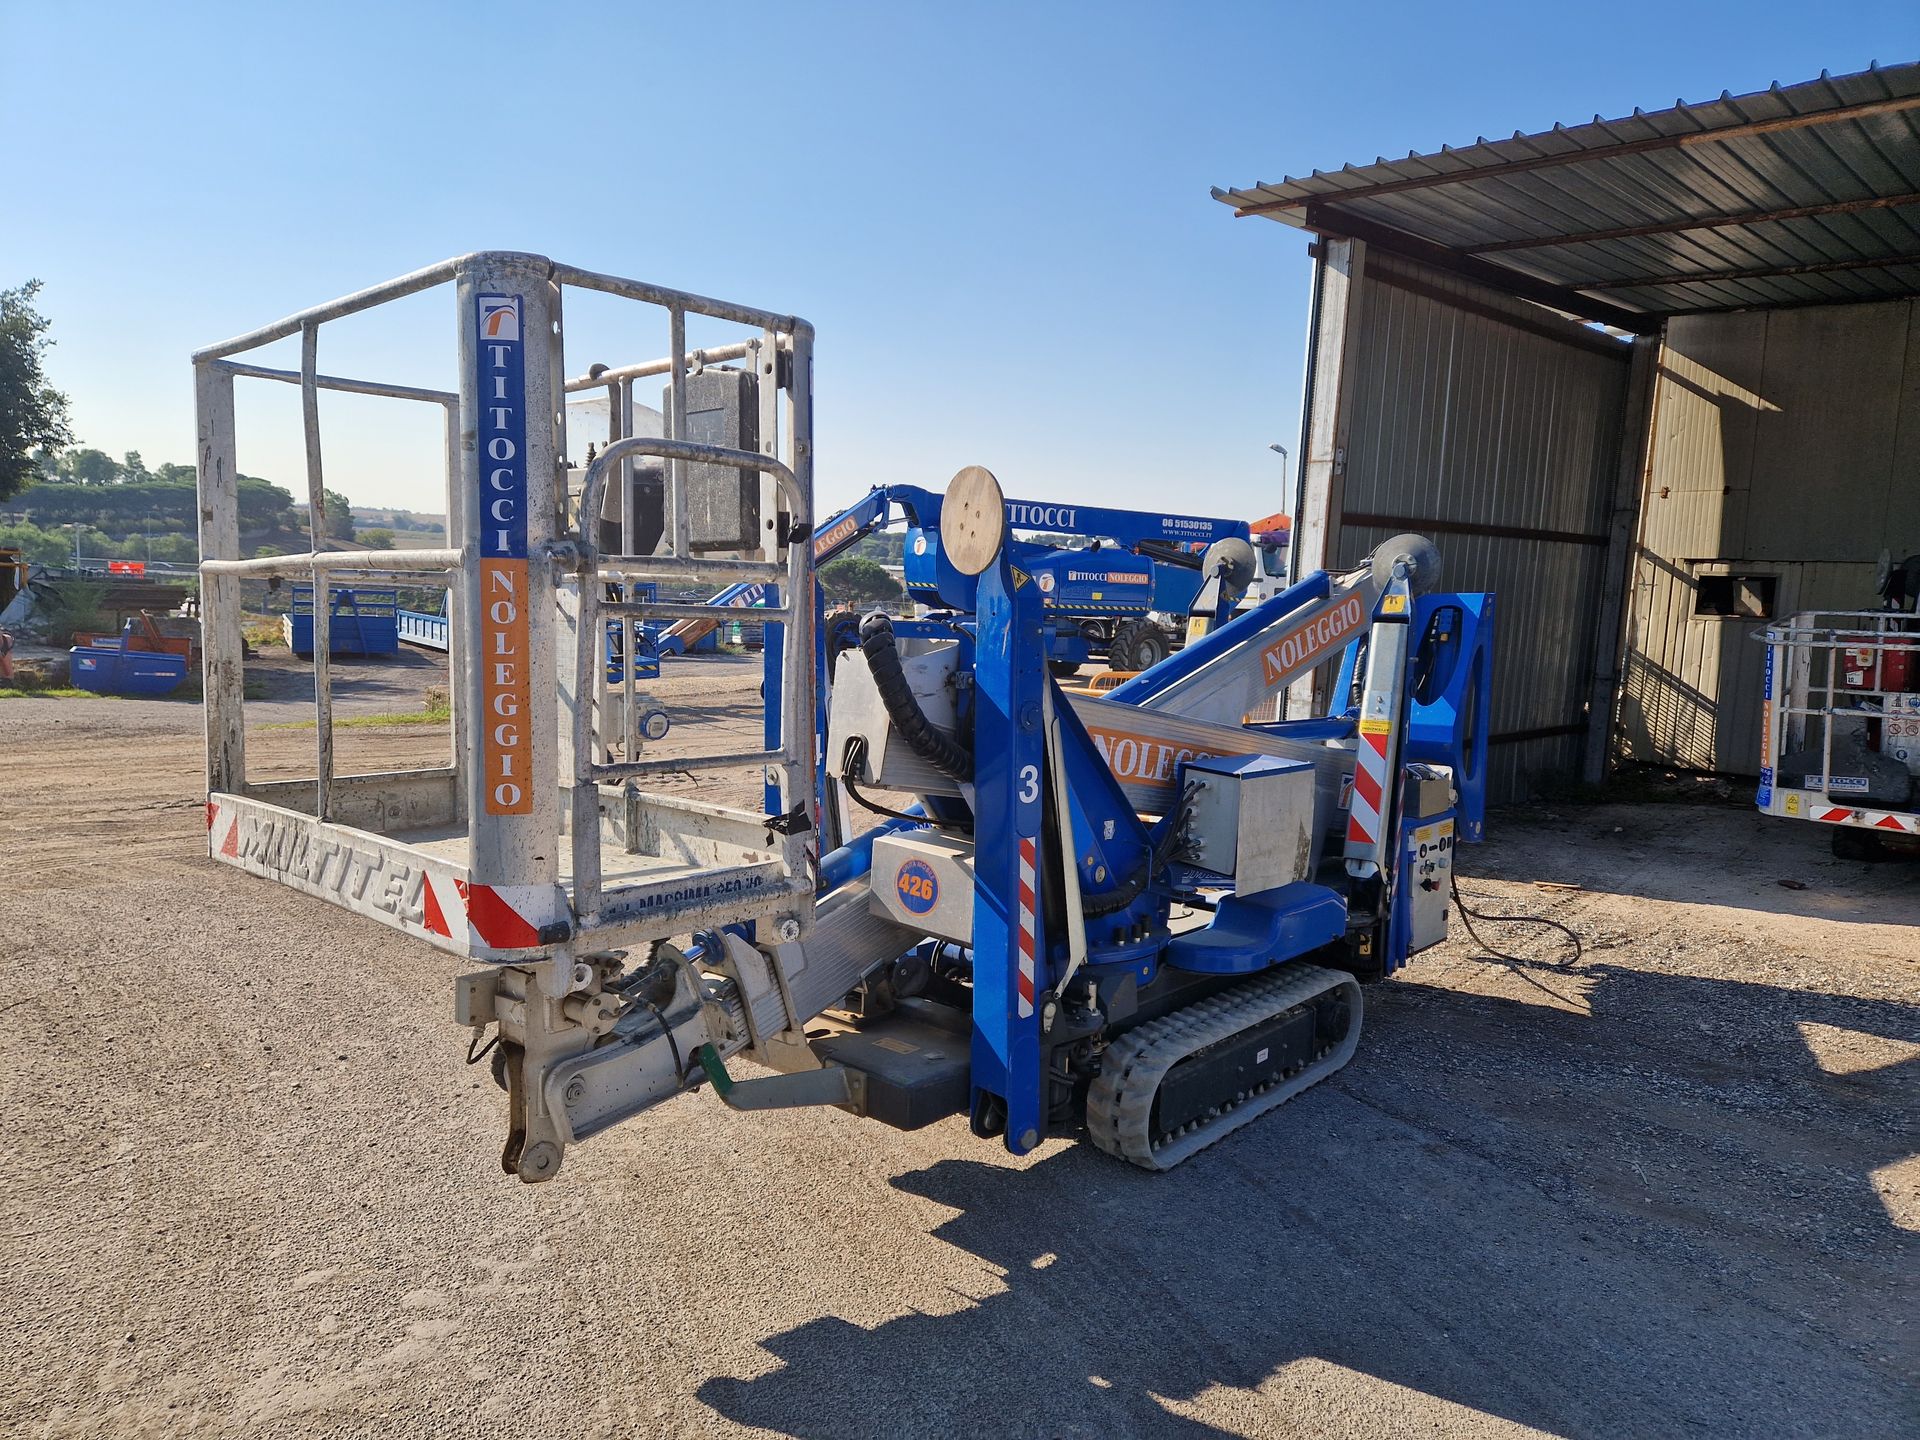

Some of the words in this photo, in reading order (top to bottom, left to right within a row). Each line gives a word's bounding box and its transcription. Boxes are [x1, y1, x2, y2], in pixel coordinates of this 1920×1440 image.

[487, 345, 516, 552] TITOCCI
[1005, 503, 1076, 528] ITOCCI
[1162, 518, 1174, 528] 06
[1174, 520, 1213, 531] 51530135
[1076, 572, 1108, 582] TITOCCI
[1108, 573, 1148, 584] NOLEGGIO
[1265, 598, 1361, 681] NOLEGGIO
[490, 570, 522, 806] NOLEGGIO
[1018, 764, 1039, 804] 3
[239, 815, 425, 925] MULTITEL
[898, 873, 933, 900] 426
